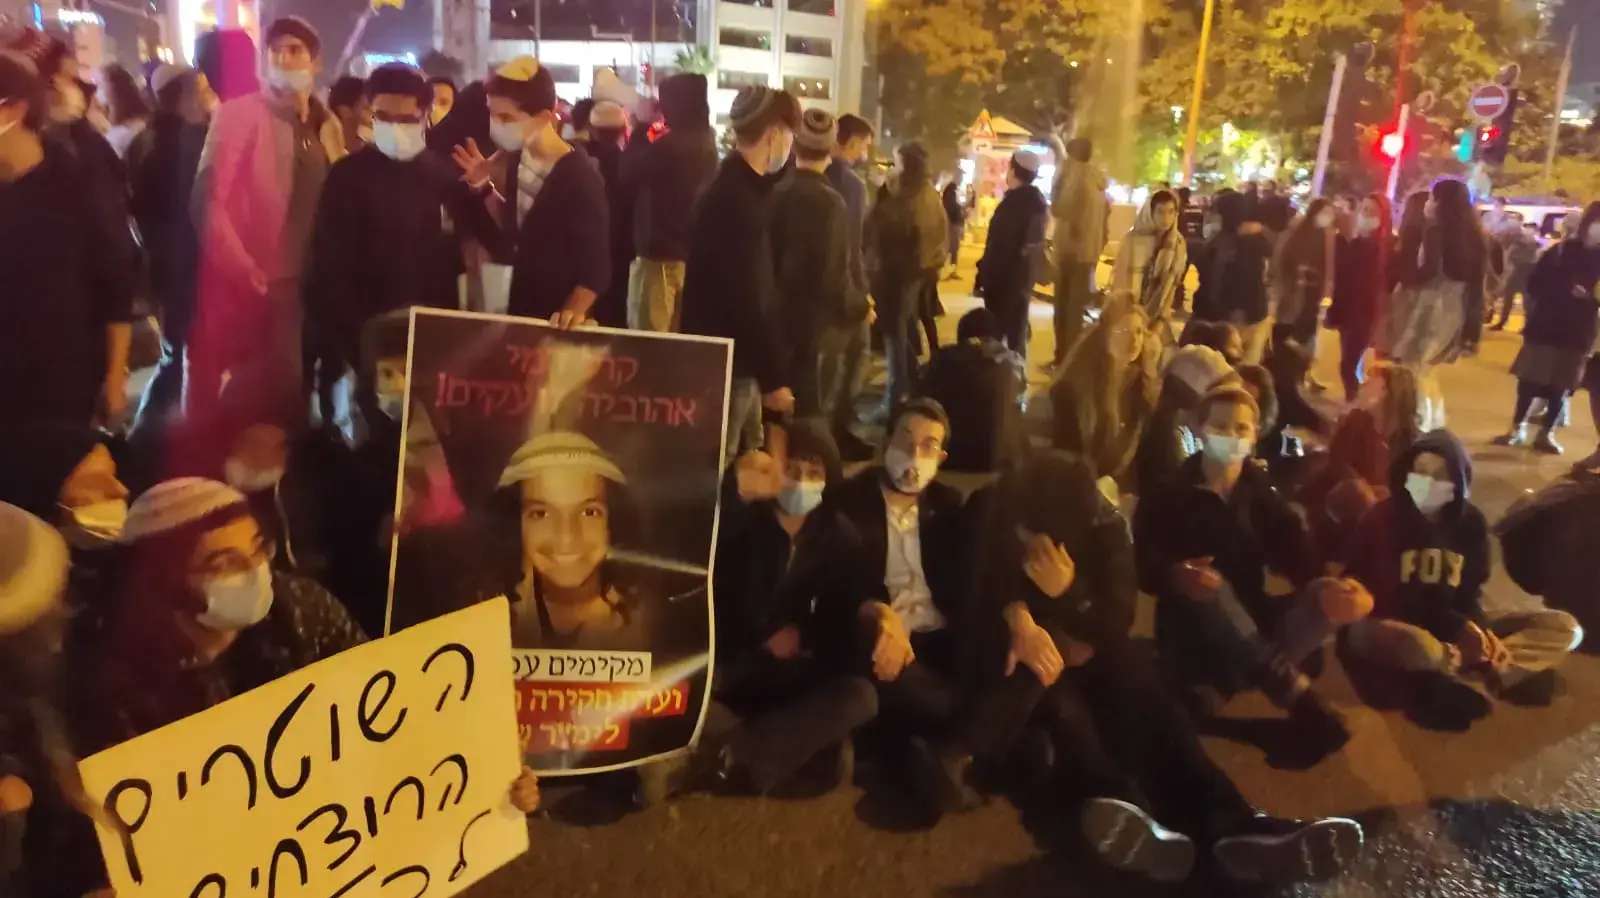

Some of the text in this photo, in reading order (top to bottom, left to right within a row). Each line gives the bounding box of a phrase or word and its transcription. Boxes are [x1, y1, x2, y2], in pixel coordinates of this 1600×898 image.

[549, 655, 644, 682] מקימים
[530, 688, 612, 715] חקירה
[103, 642, 475, 885] השוטרים
